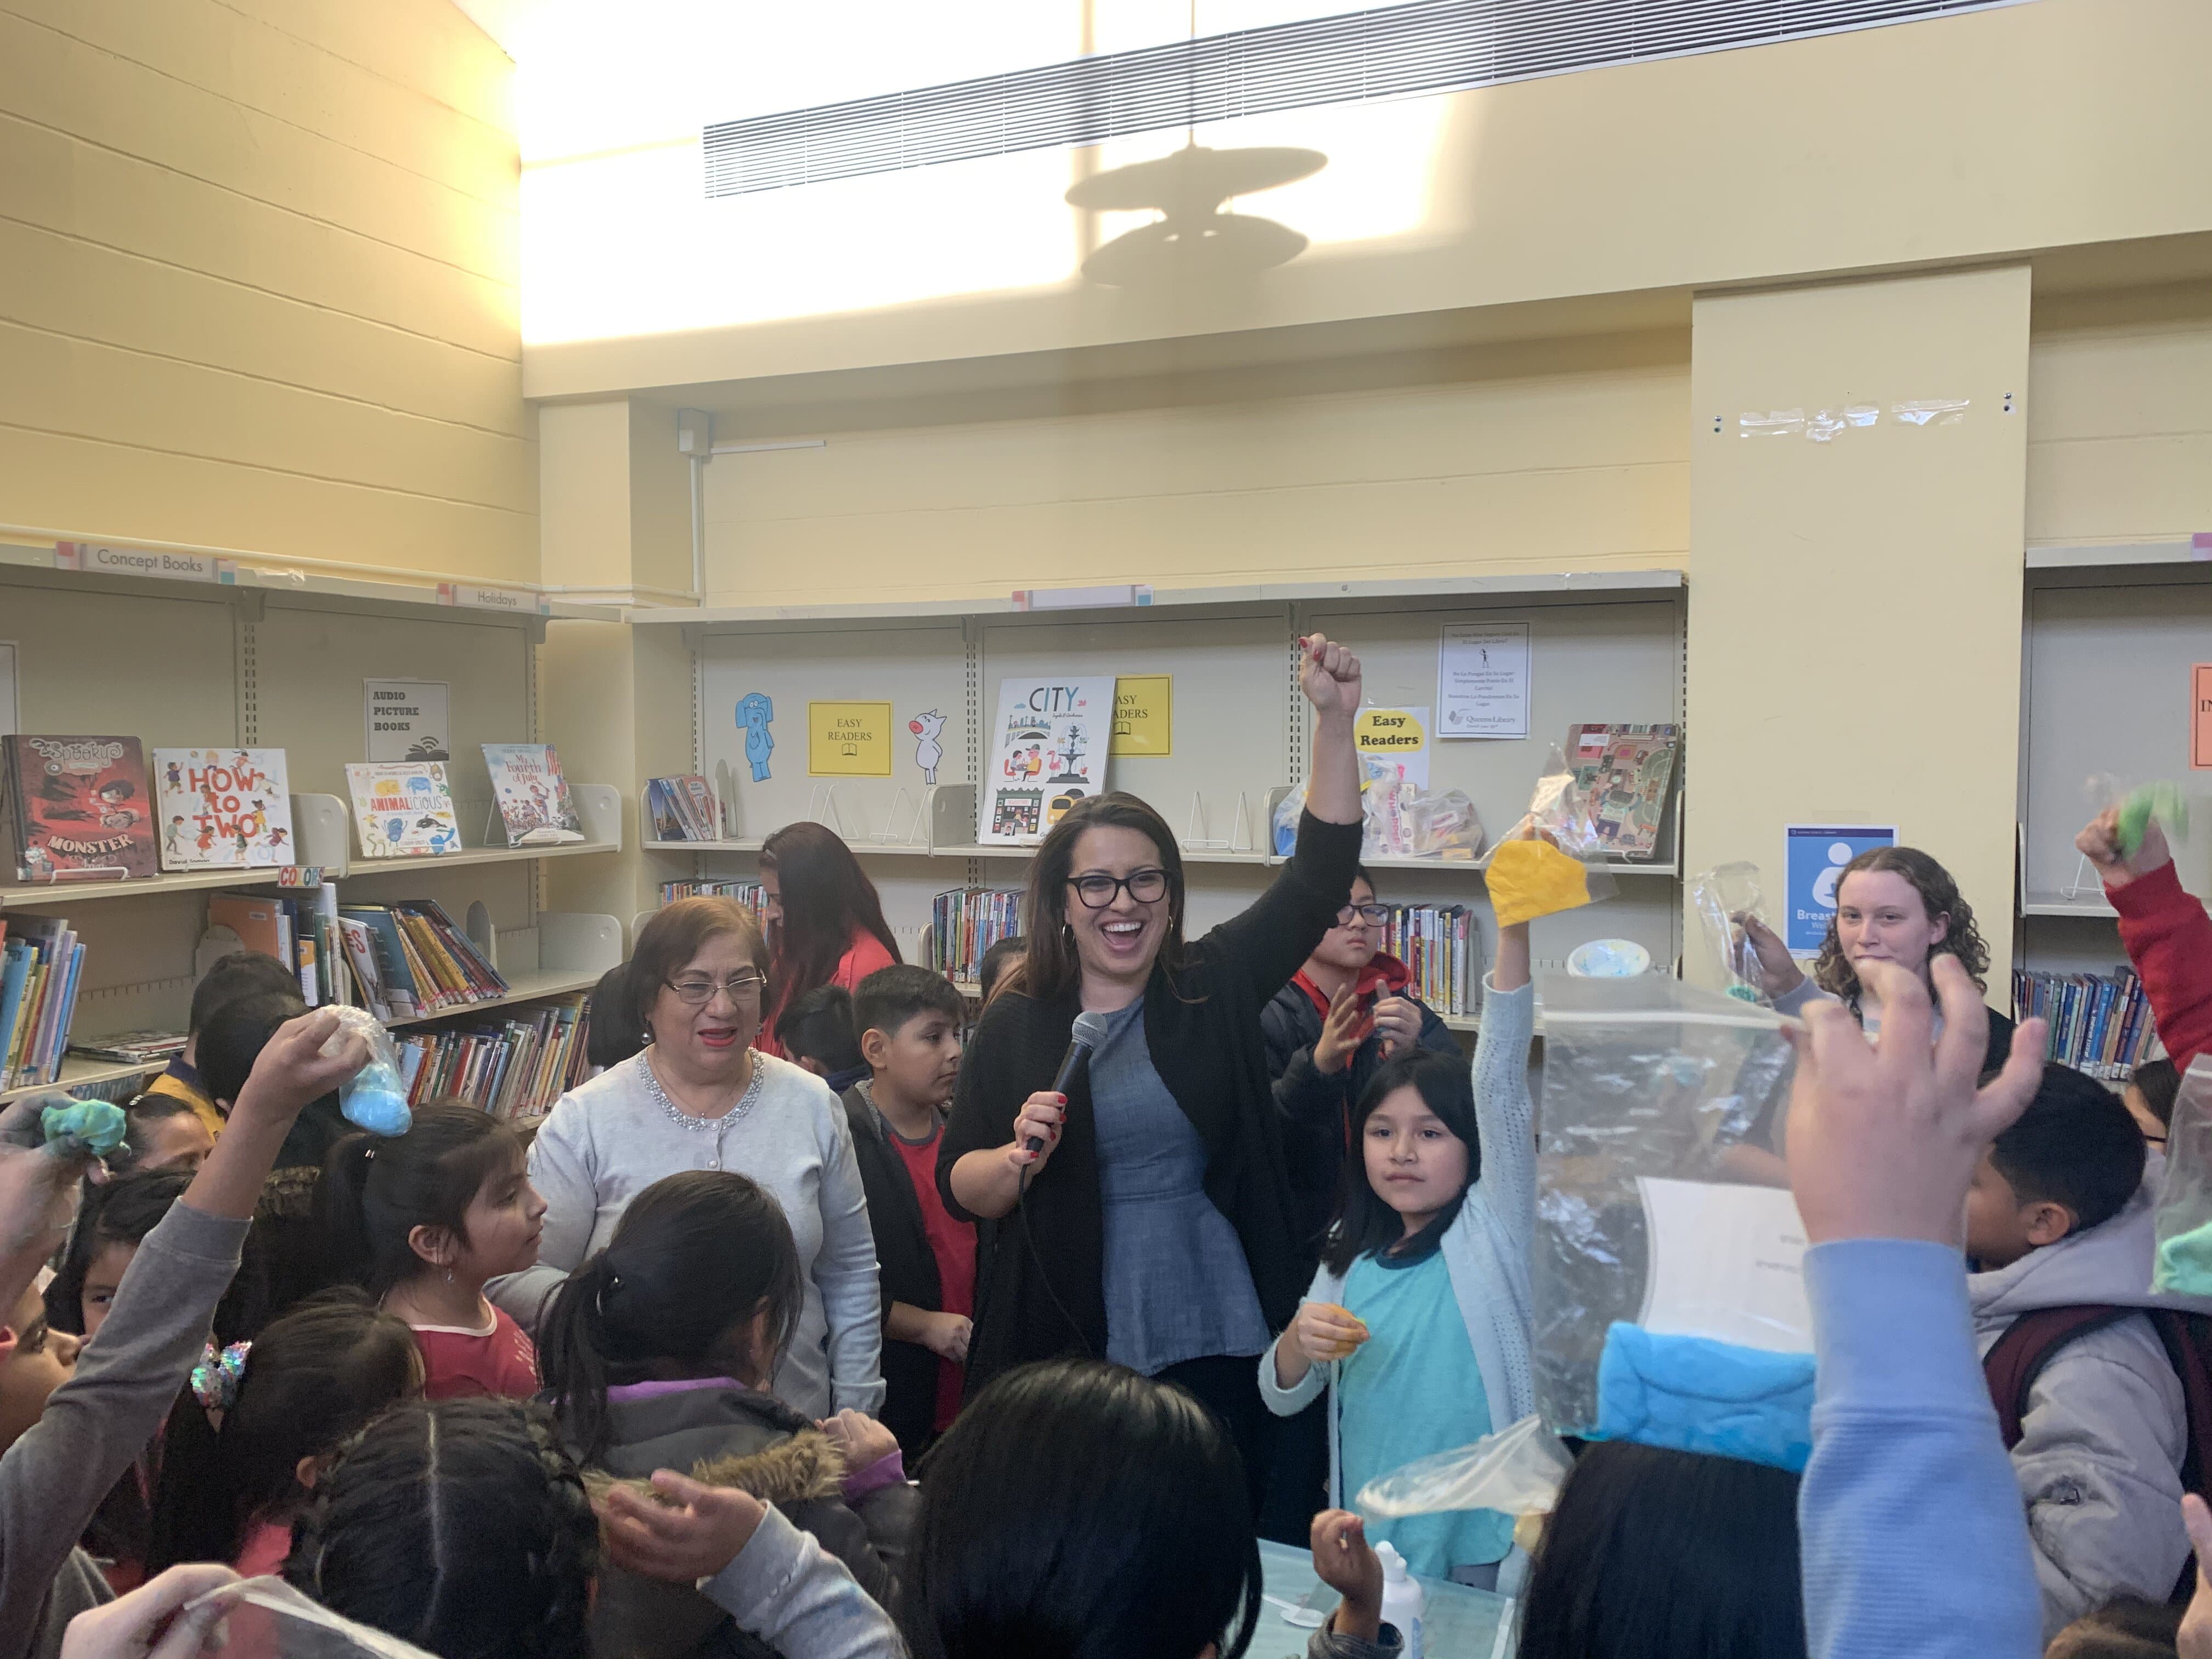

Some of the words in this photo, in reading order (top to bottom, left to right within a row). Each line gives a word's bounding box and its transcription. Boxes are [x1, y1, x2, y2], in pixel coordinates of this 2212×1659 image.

[97, 549, 157, 571] Concept
[163, 555, 202, 572] Books
[478, 590, 517, 607] Holidays
[373, 691, 406, 700] AUDIO
[1029, 687, 1079, 712] CITY
[373, 707, 419, 716] PICTURE
[374, 722, 410, 731] BOOKS
[837, 718, 862, 727] EASY
[1372, 715, 1406, 727] Easy
[1492, 716, 1516, 724] Library
[828, 731, 872, 741] READERS
[1360, 735, 1419, 746] Readers
[515, 754, 528, 764] My
[505, 759, 542, 774] Fourth
[188, 768, 255, 792] HOW
[519, 772, 538, 785] July
[210, 792, 241, 814] to
[193, 814, 258, 839] TWO
[47, 833, 134, 854] MONSTER
[280, 867, 325, 887] COLORS
